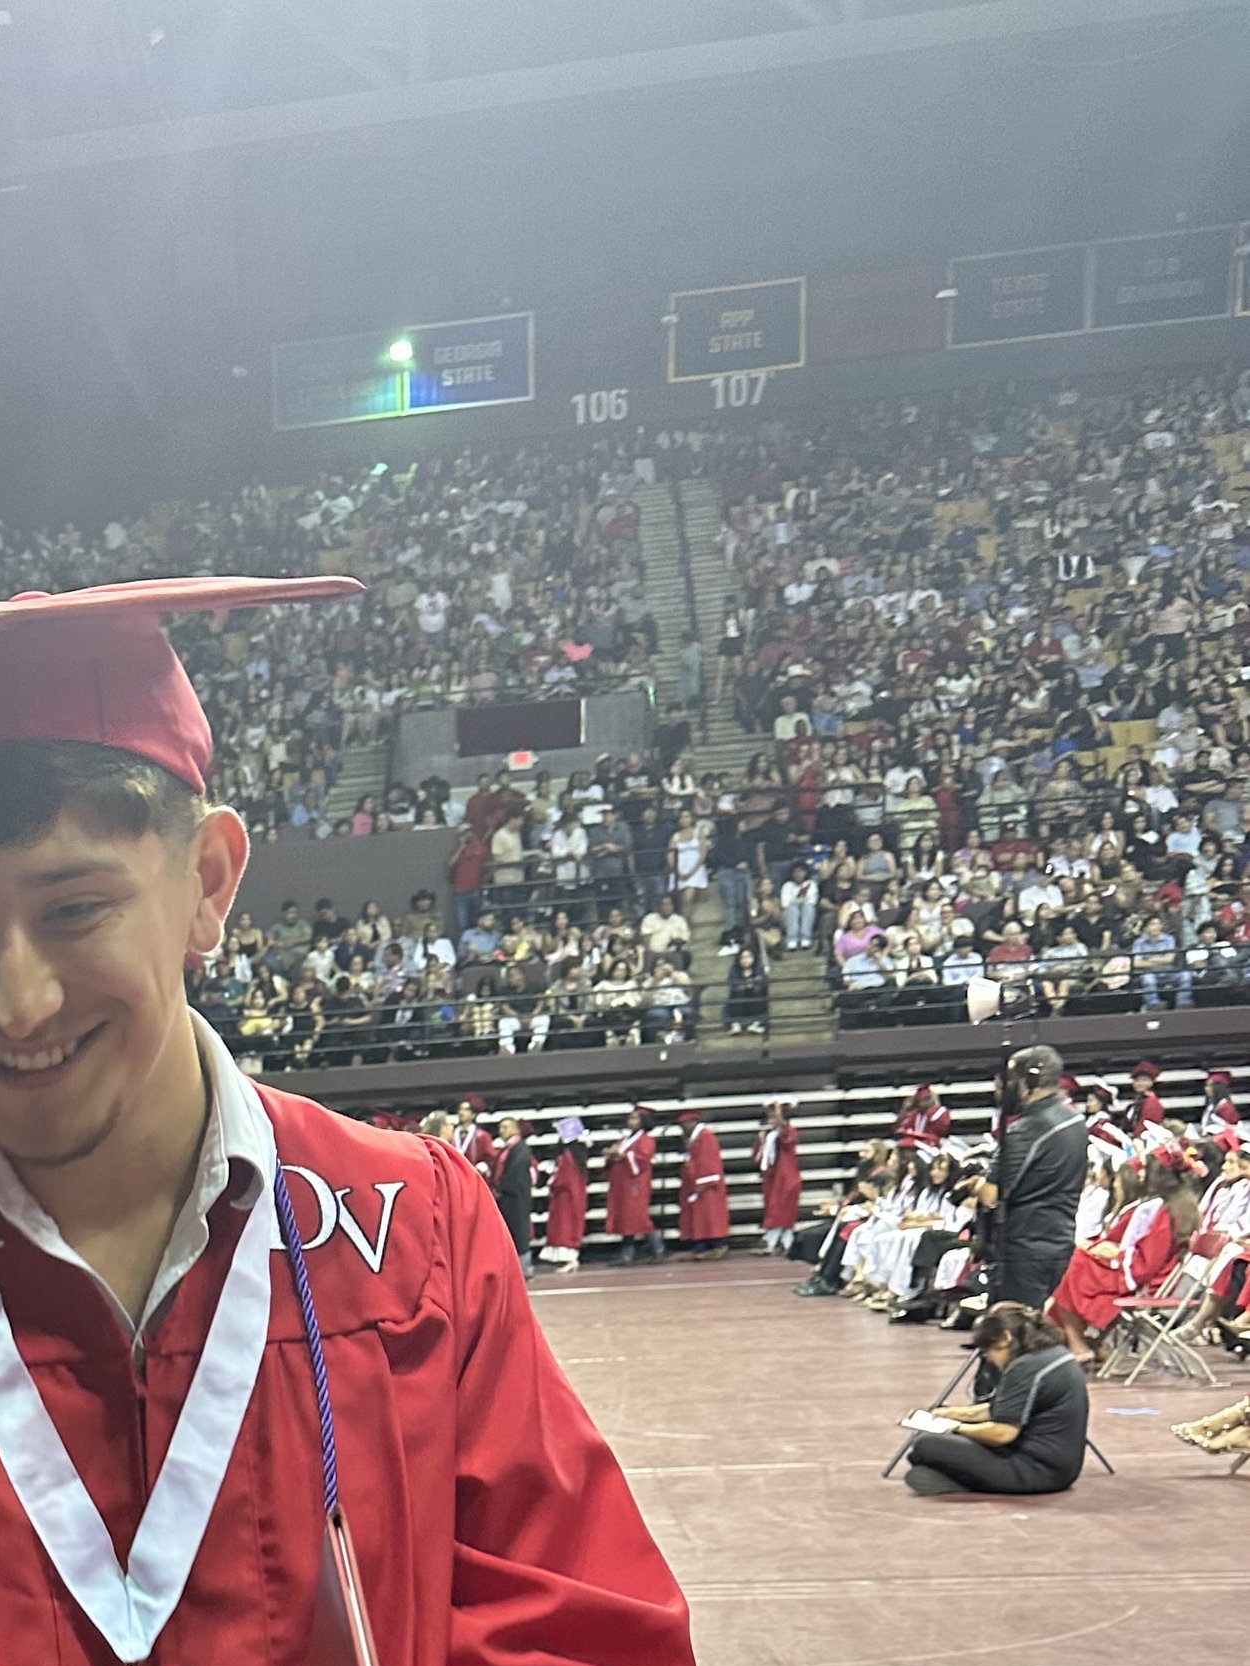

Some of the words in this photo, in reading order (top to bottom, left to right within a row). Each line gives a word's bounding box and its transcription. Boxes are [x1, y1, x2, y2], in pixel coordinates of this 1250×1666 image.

[708, 330, 765, 354] STATE
[441, 364, 496, 388] STATE
[710, 371, 768, 410] 107
[570, 388, 629, 425] 106
[270, 1164, 406, 1275] DV
